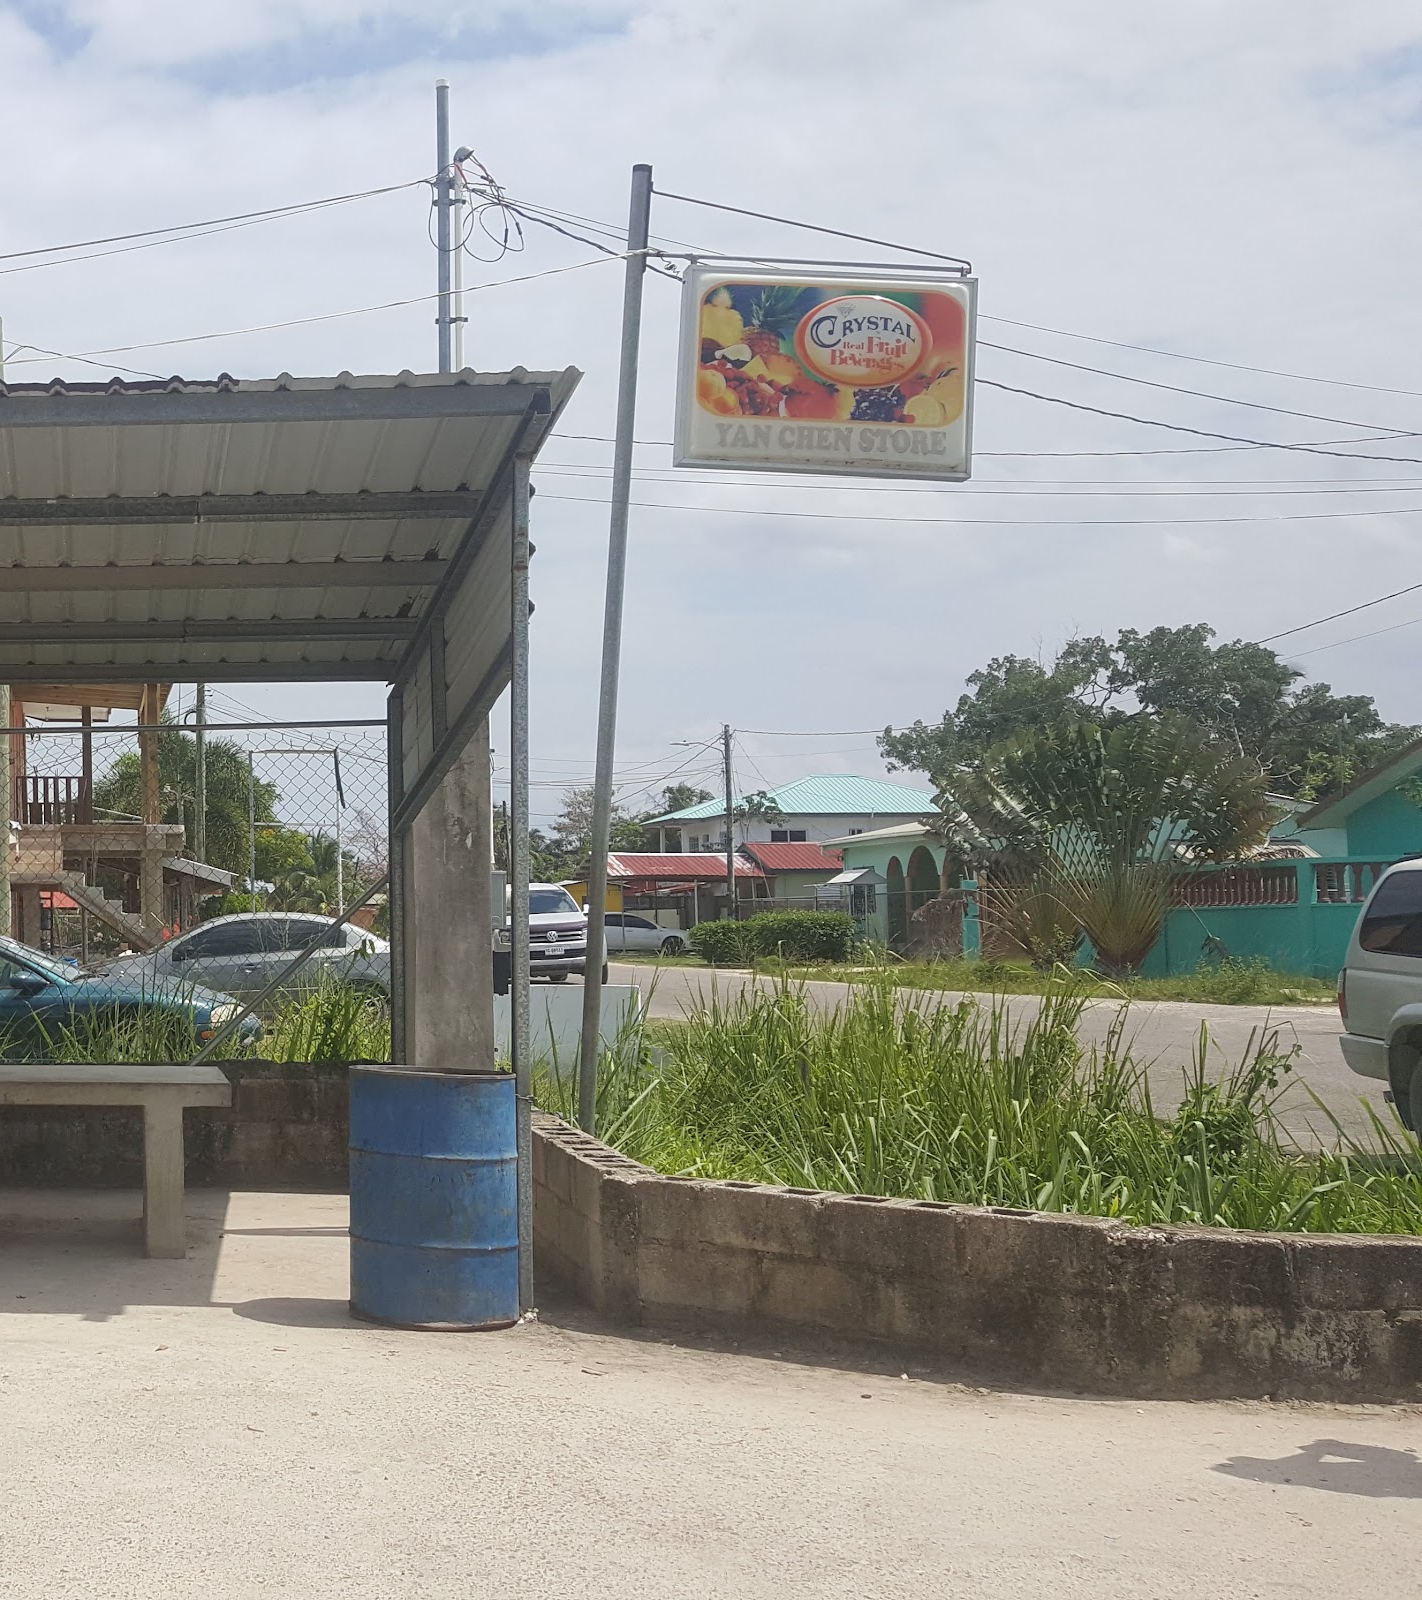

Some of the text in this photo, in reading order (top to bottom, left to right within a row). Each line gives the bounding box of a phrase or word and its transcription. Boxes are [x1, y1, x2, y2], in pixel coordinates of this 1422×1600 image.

[810, 315, 916, 349] CRYSTAL
[843, 336, 908, 358] Real Fruit
[830, 348, 905, 374] Beverages
[714, 422, 947, 456] YAN CHEN STORE
